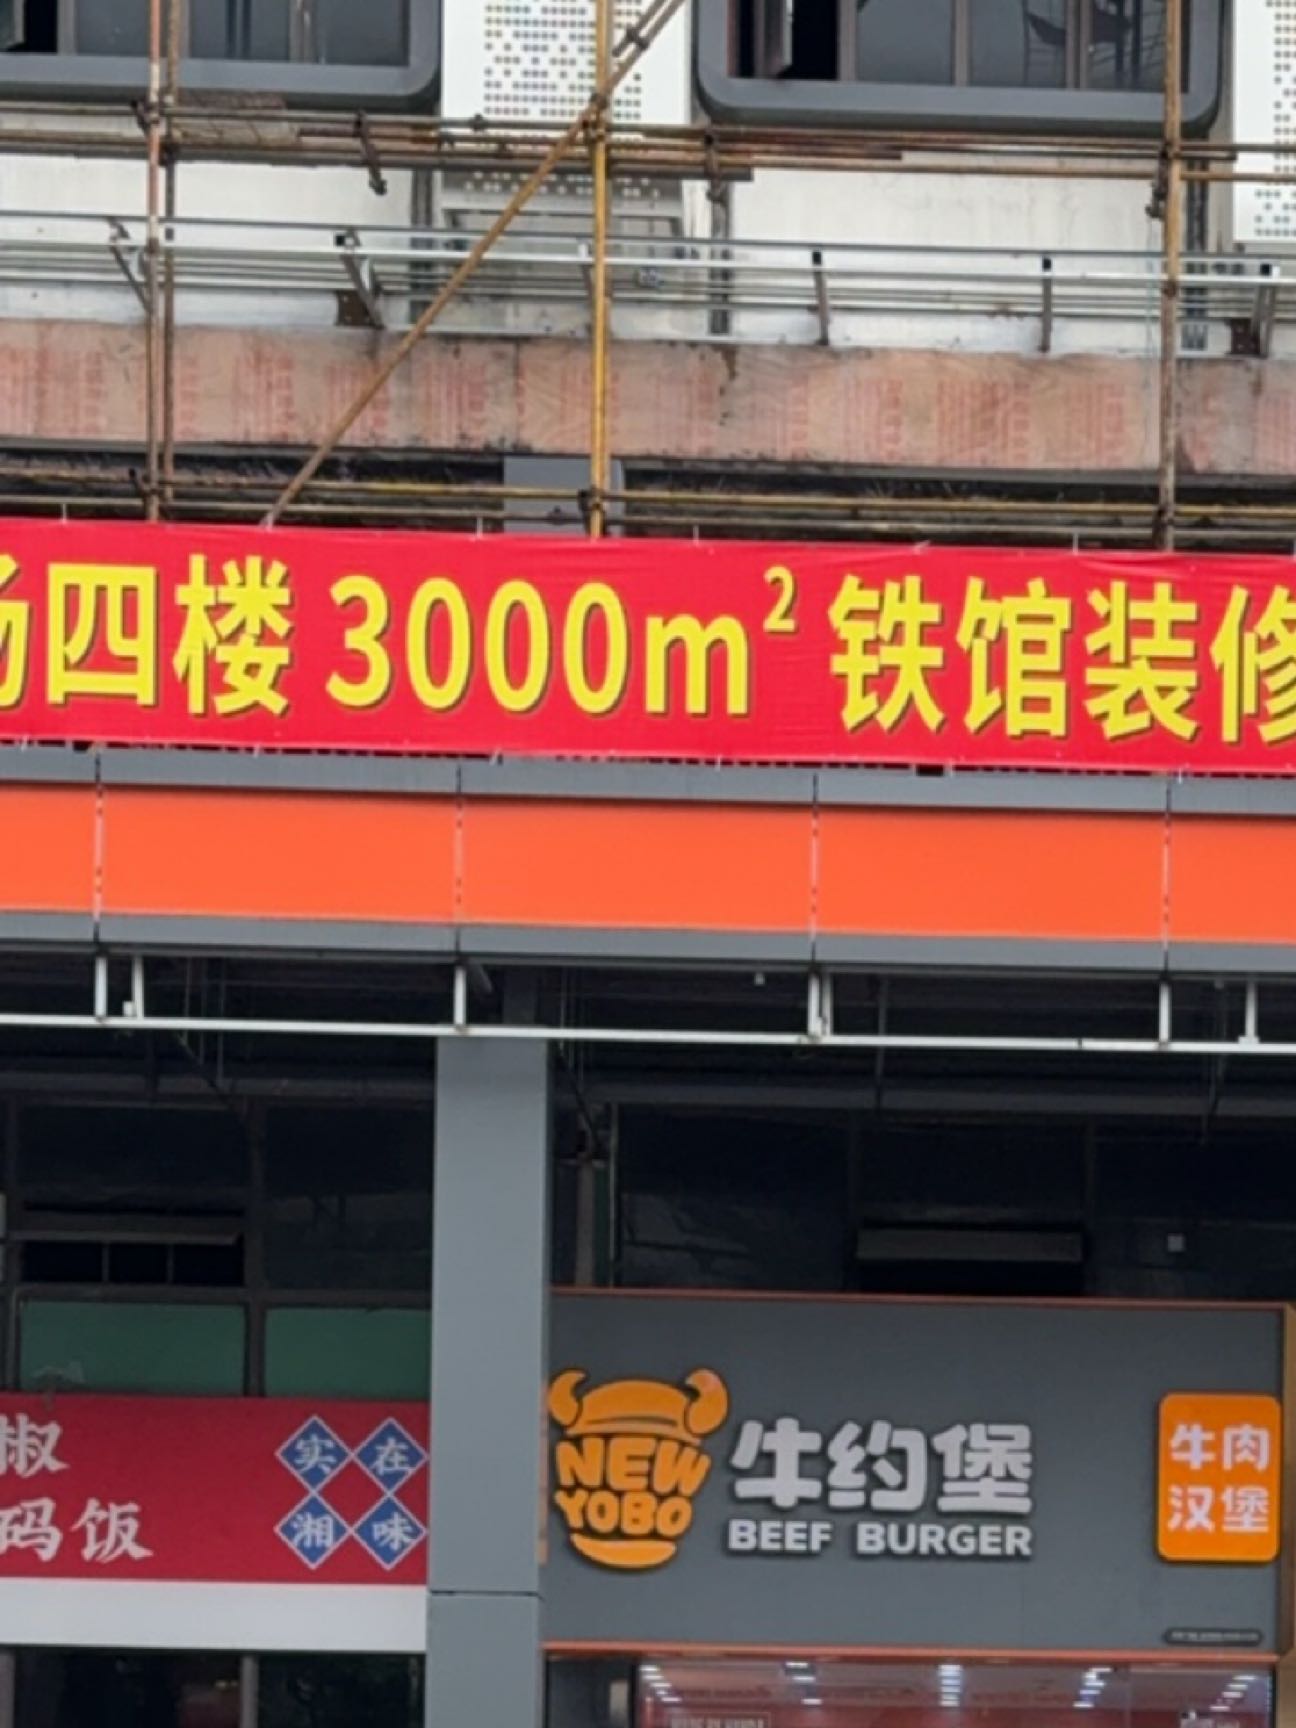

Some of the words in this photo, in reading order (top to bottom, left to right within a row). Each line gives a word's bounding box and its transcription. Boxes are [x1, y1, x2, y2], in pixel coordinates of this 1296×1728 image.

[294, 1435, 415, 1476] 实在
[556, 1438, 711, 1497] NEW
[729, 1417, 1033, 1514] 牛约堡
[1169, 1423, 1270, 1472] 牛肉
[291, 1511, 415, 1550] 湘味
[554, 1489, 692, 1537] YOBO
[1168, 1485, 1270, 1535] 汉堡
[728, 1520, 833, 1553] BEEF
[856, 1523, 1033, 1557] BURGER
